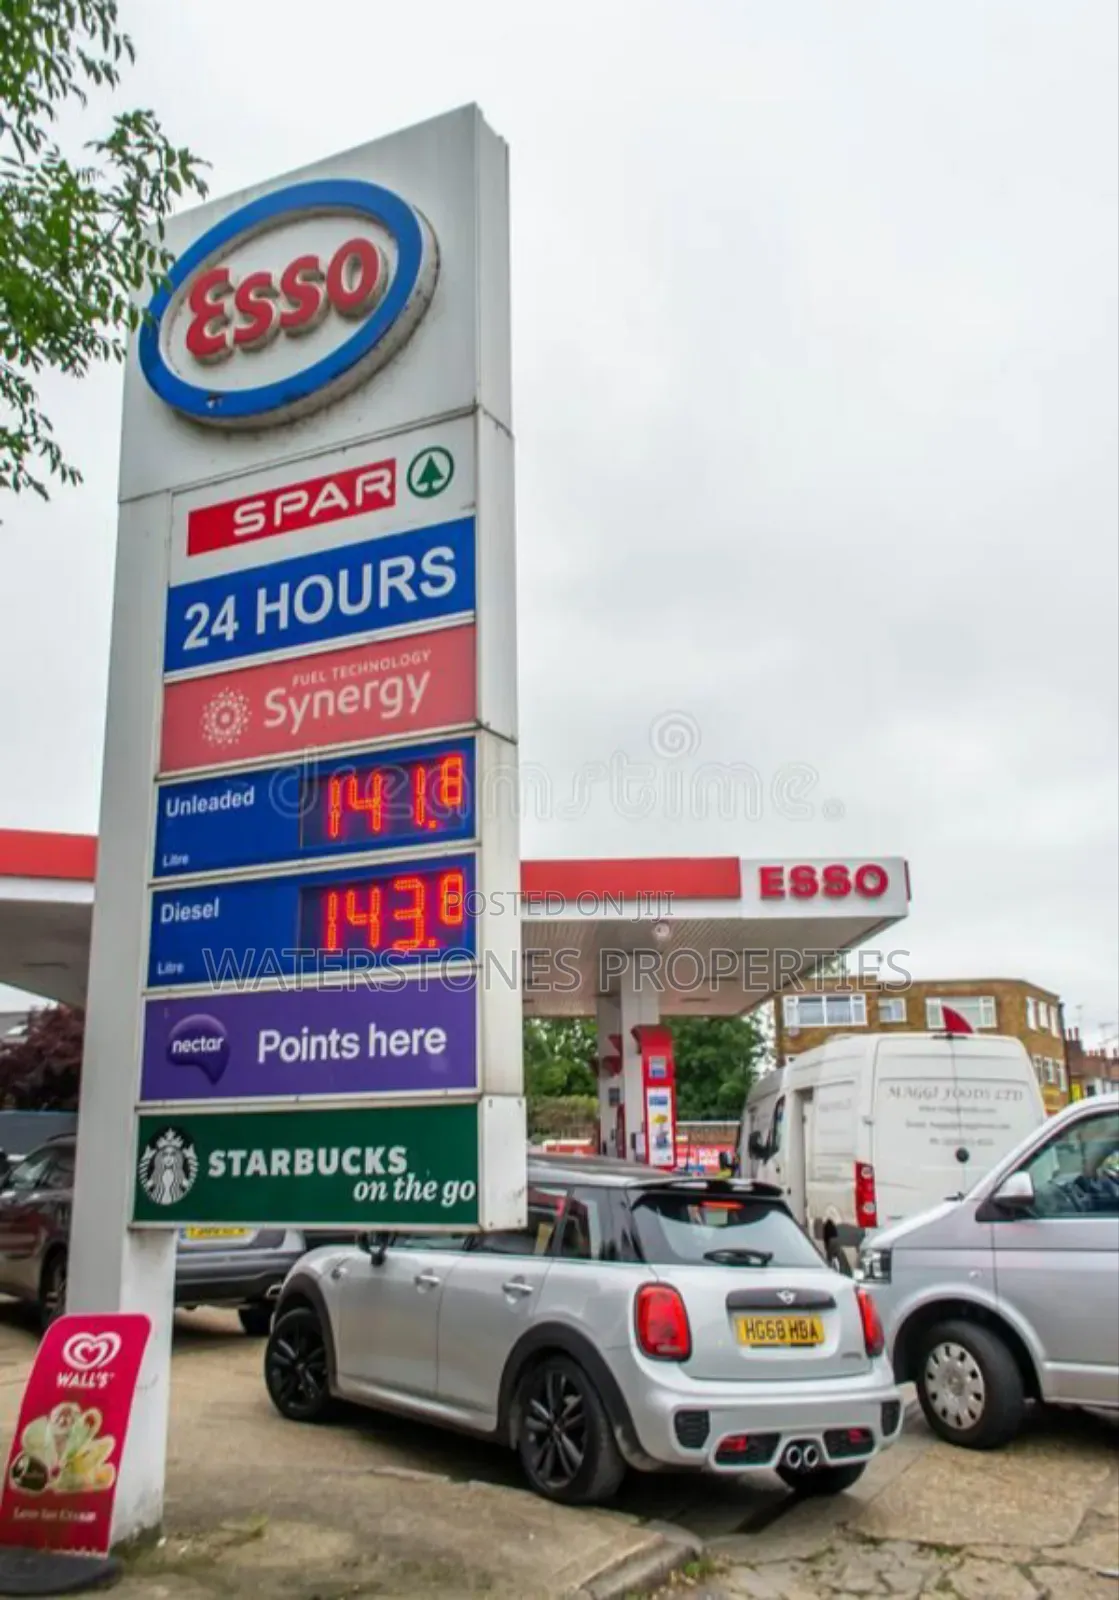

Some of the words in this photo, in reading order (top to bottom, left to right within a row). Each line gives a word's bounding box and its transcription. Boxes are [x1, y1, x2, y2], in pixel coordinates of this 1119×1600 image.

[233, 468, 392, 537] SPAR
[182, 594, 239, 651] 24
[256, 546, 456, 635] HOURS
[292, 672, 327, 688] FUEL
[332, 649, 432, 681] TECHNOLOGY
[263, 670, 431, 736] Synergy
[165, 786, 255, 818] Unleaded
[330, 756, 462, 838] 141.8
[162, 854, 189, 868] Litre
[759, 864, 888, 899] ESSO
[160, 897, 220, 924] Diesel
[157, 961, 184, 976] Litre
[172, 1034, 224, 1054] nectar
[257, 1026, 360, 1064] Points
[368, 1023, 448, 1058] here
[207, 1146, 408, 1178] STARBUCKS
[353, 1180, 387, 1201] on
[394, 1173, 436, 1201] the
[441, 1179, 476, 1208] go
